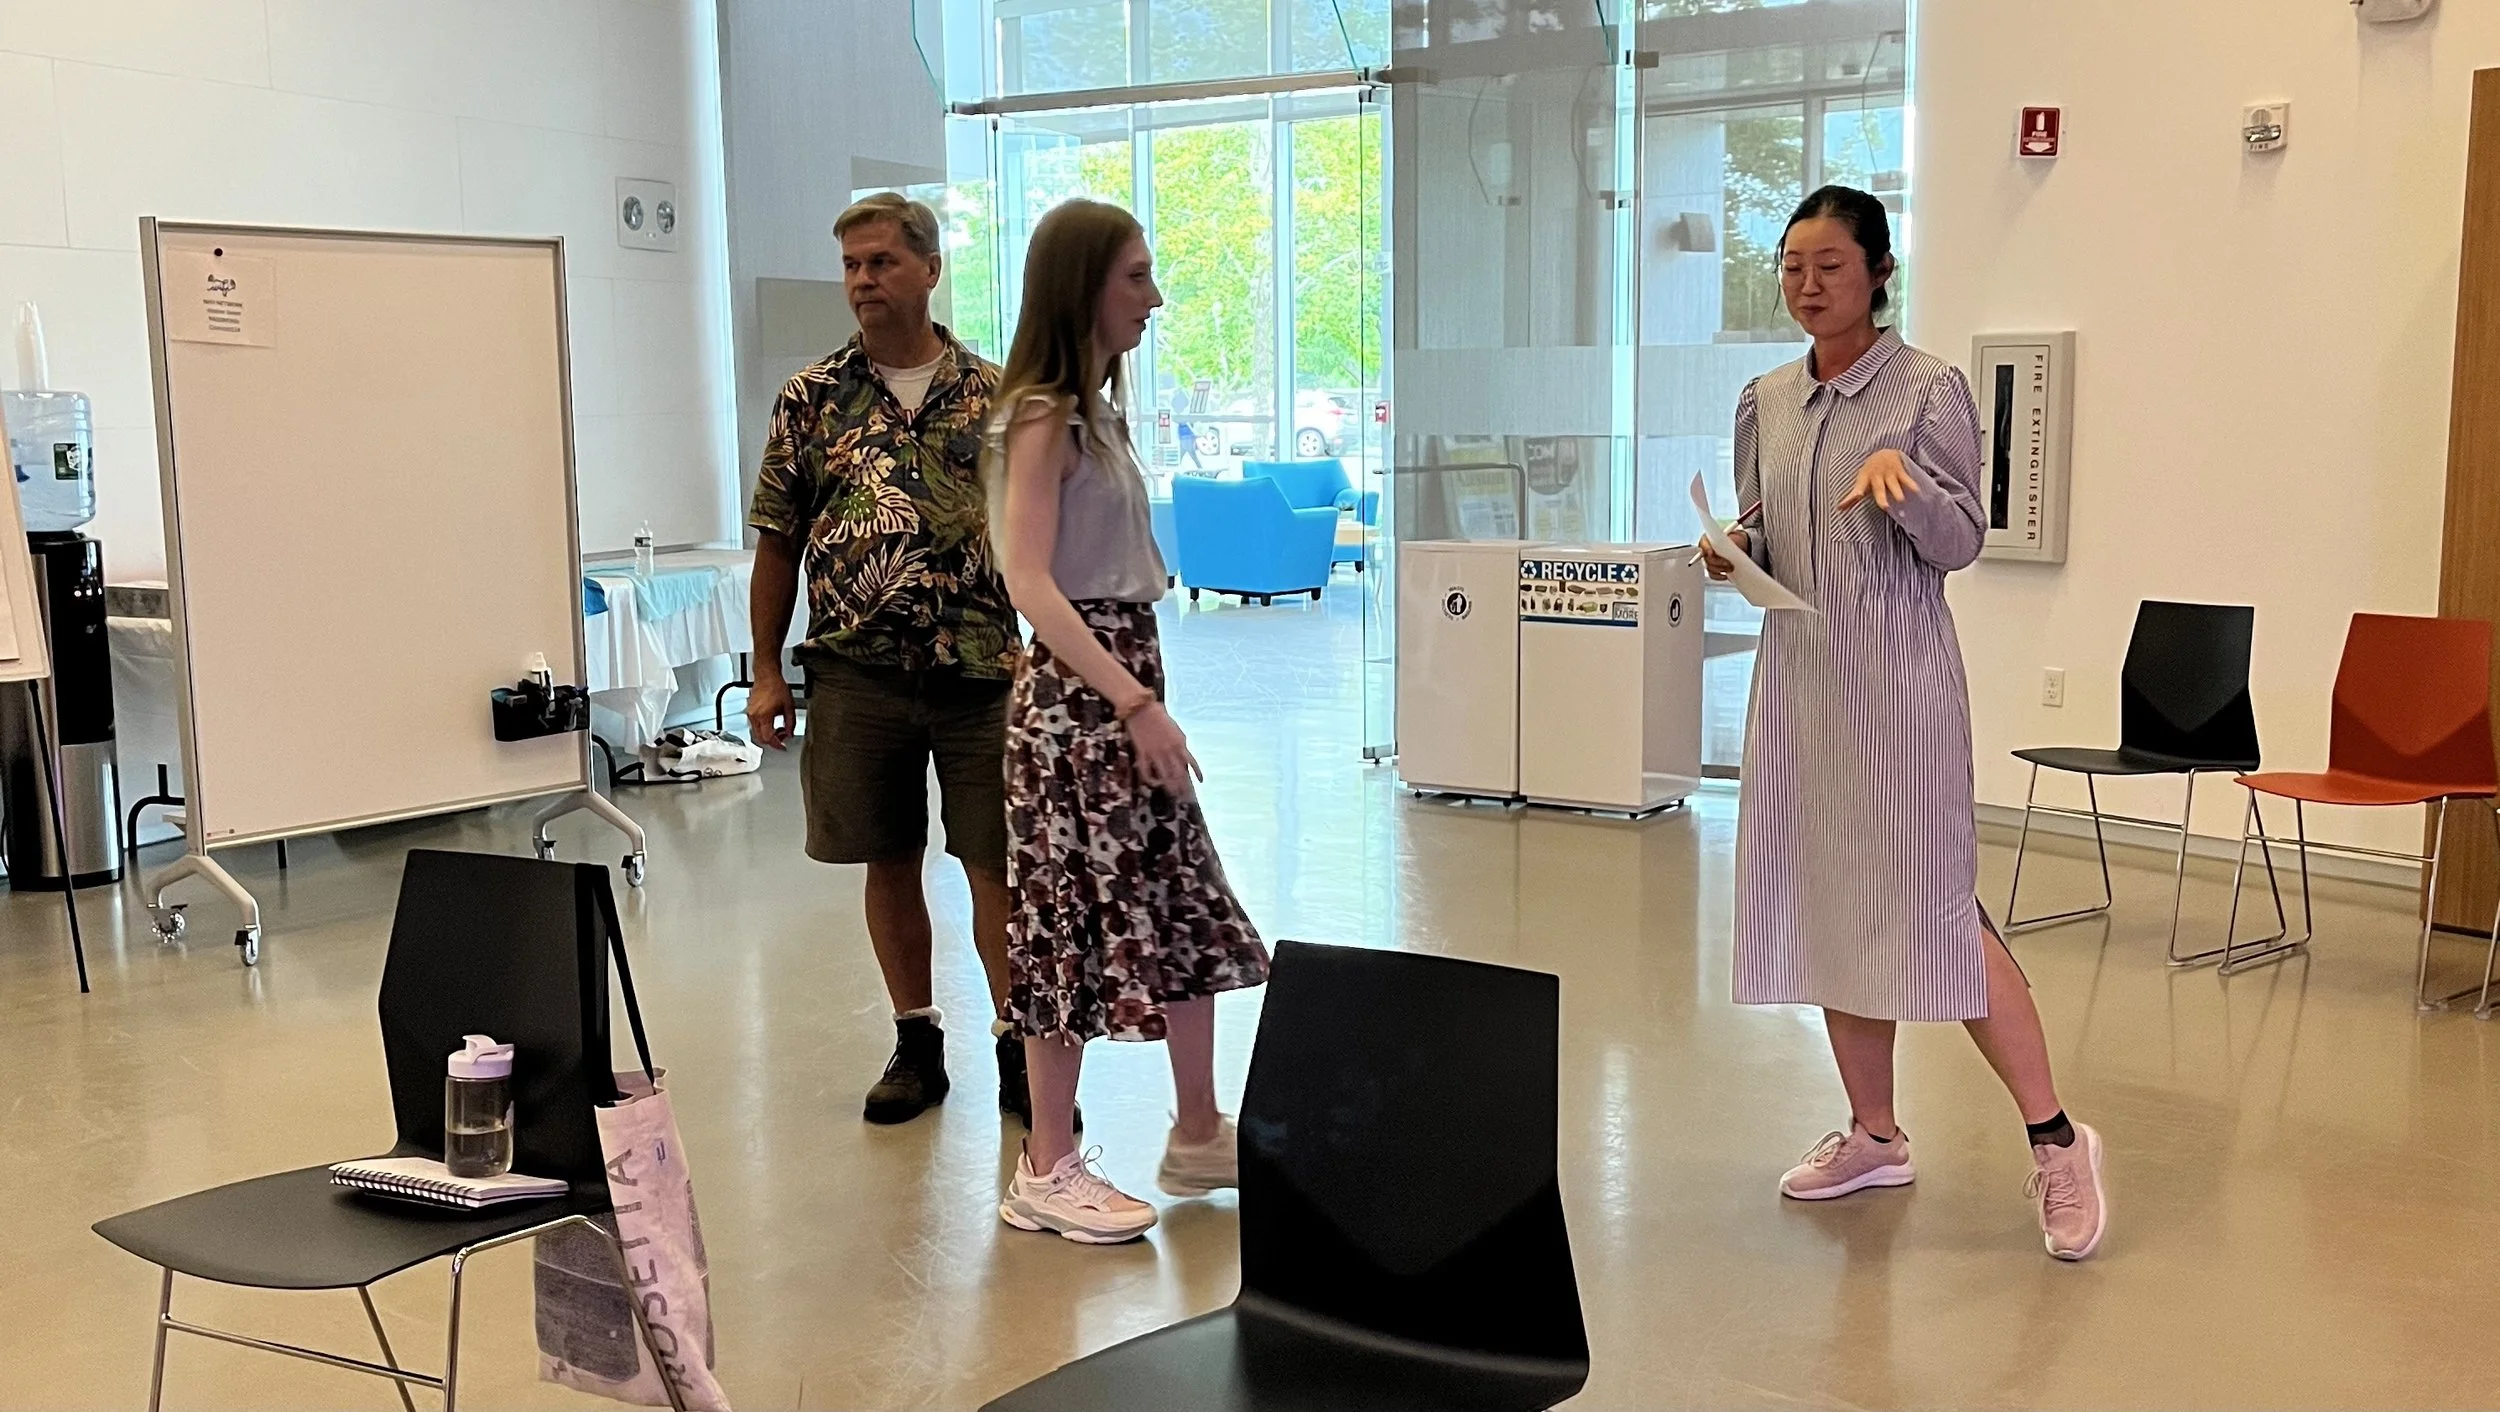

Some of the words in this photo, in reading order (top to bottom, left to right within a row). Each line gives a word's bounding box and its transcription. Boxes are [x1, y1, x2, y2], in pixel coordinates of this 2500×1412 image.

[2033, 354, 2044, 393] FIRE
[2027, 408, 2041, 541] EXTINGUISHER
[1541, 561, 1618, 583] RECYCLE
